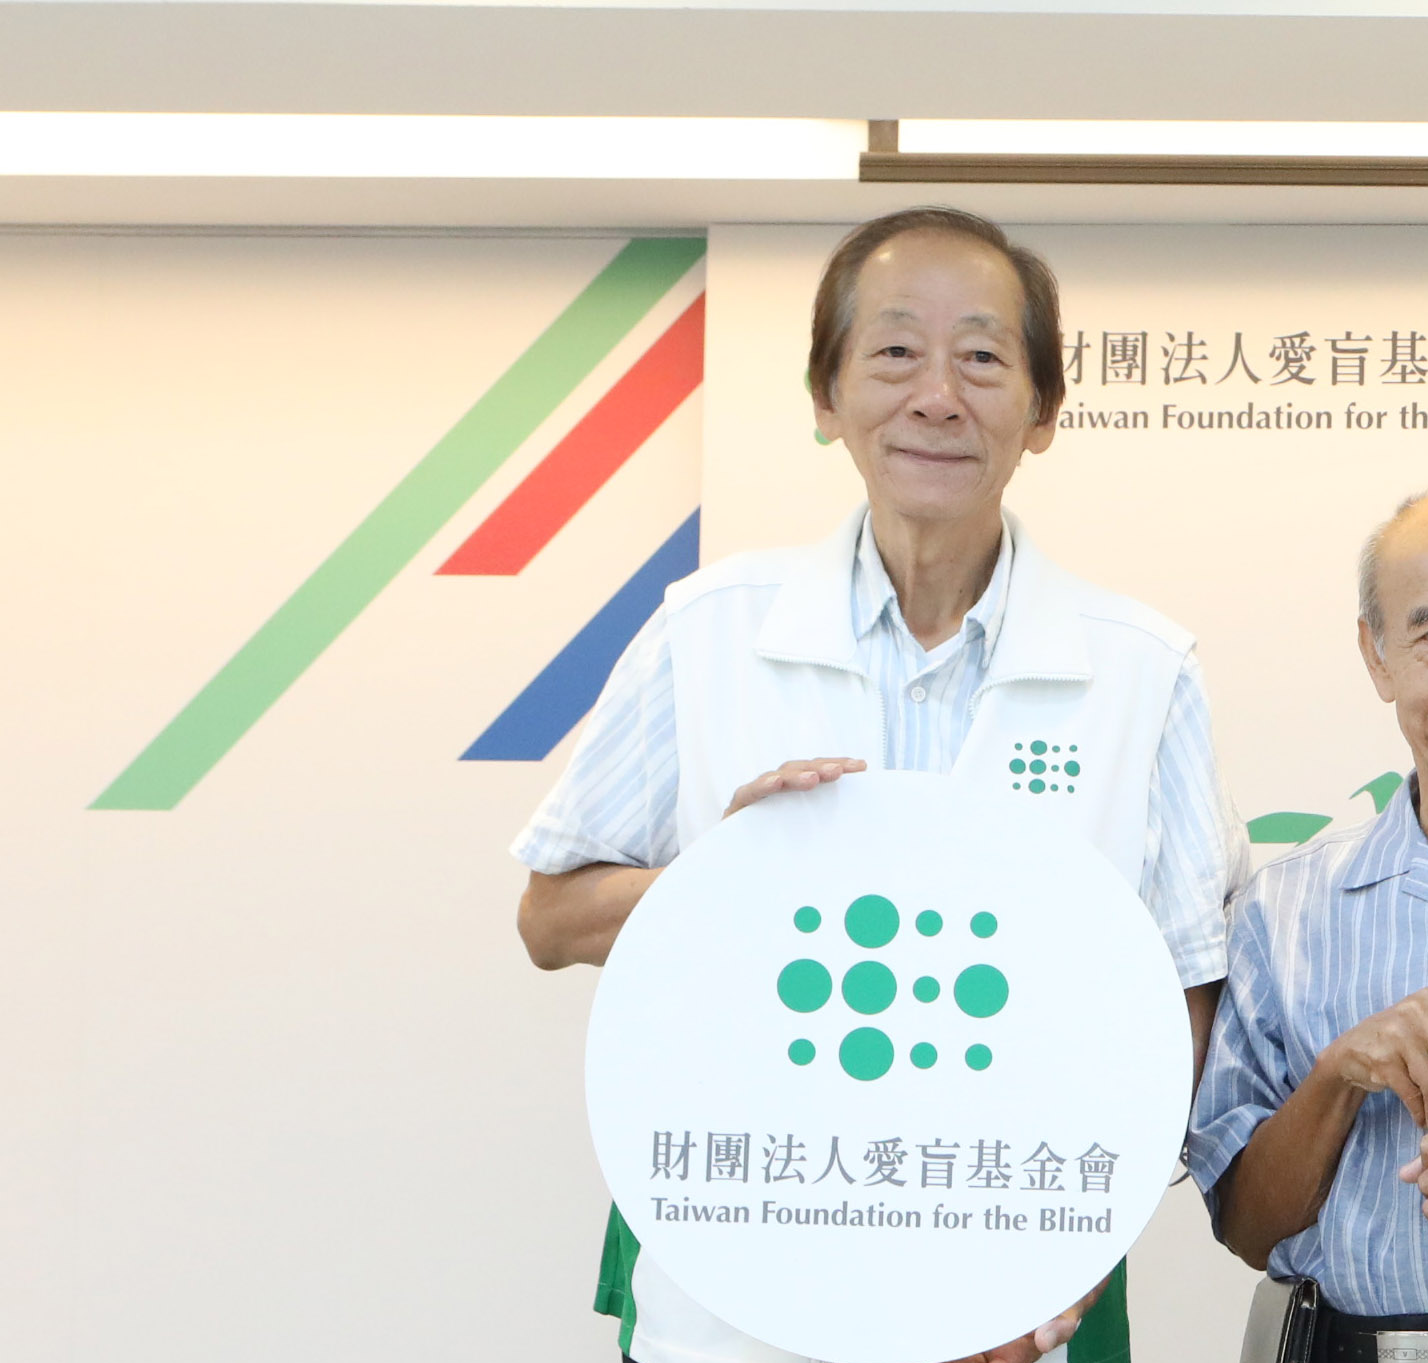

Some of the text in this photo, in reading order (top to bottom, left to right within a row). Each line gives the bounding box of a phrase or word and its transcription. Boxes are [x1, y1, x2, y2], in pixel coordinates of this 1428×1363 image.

[1059, 402, 1149, 429] aiwan
[1162, 402, 1332, 430] Foundation
[1345, 402, 1387, 429] for
[650, 1130, 1120, 1194] 財團法人愛盲基金會
[650, 1197, 1112, 1233] Taiwan Foundation for the Blind
